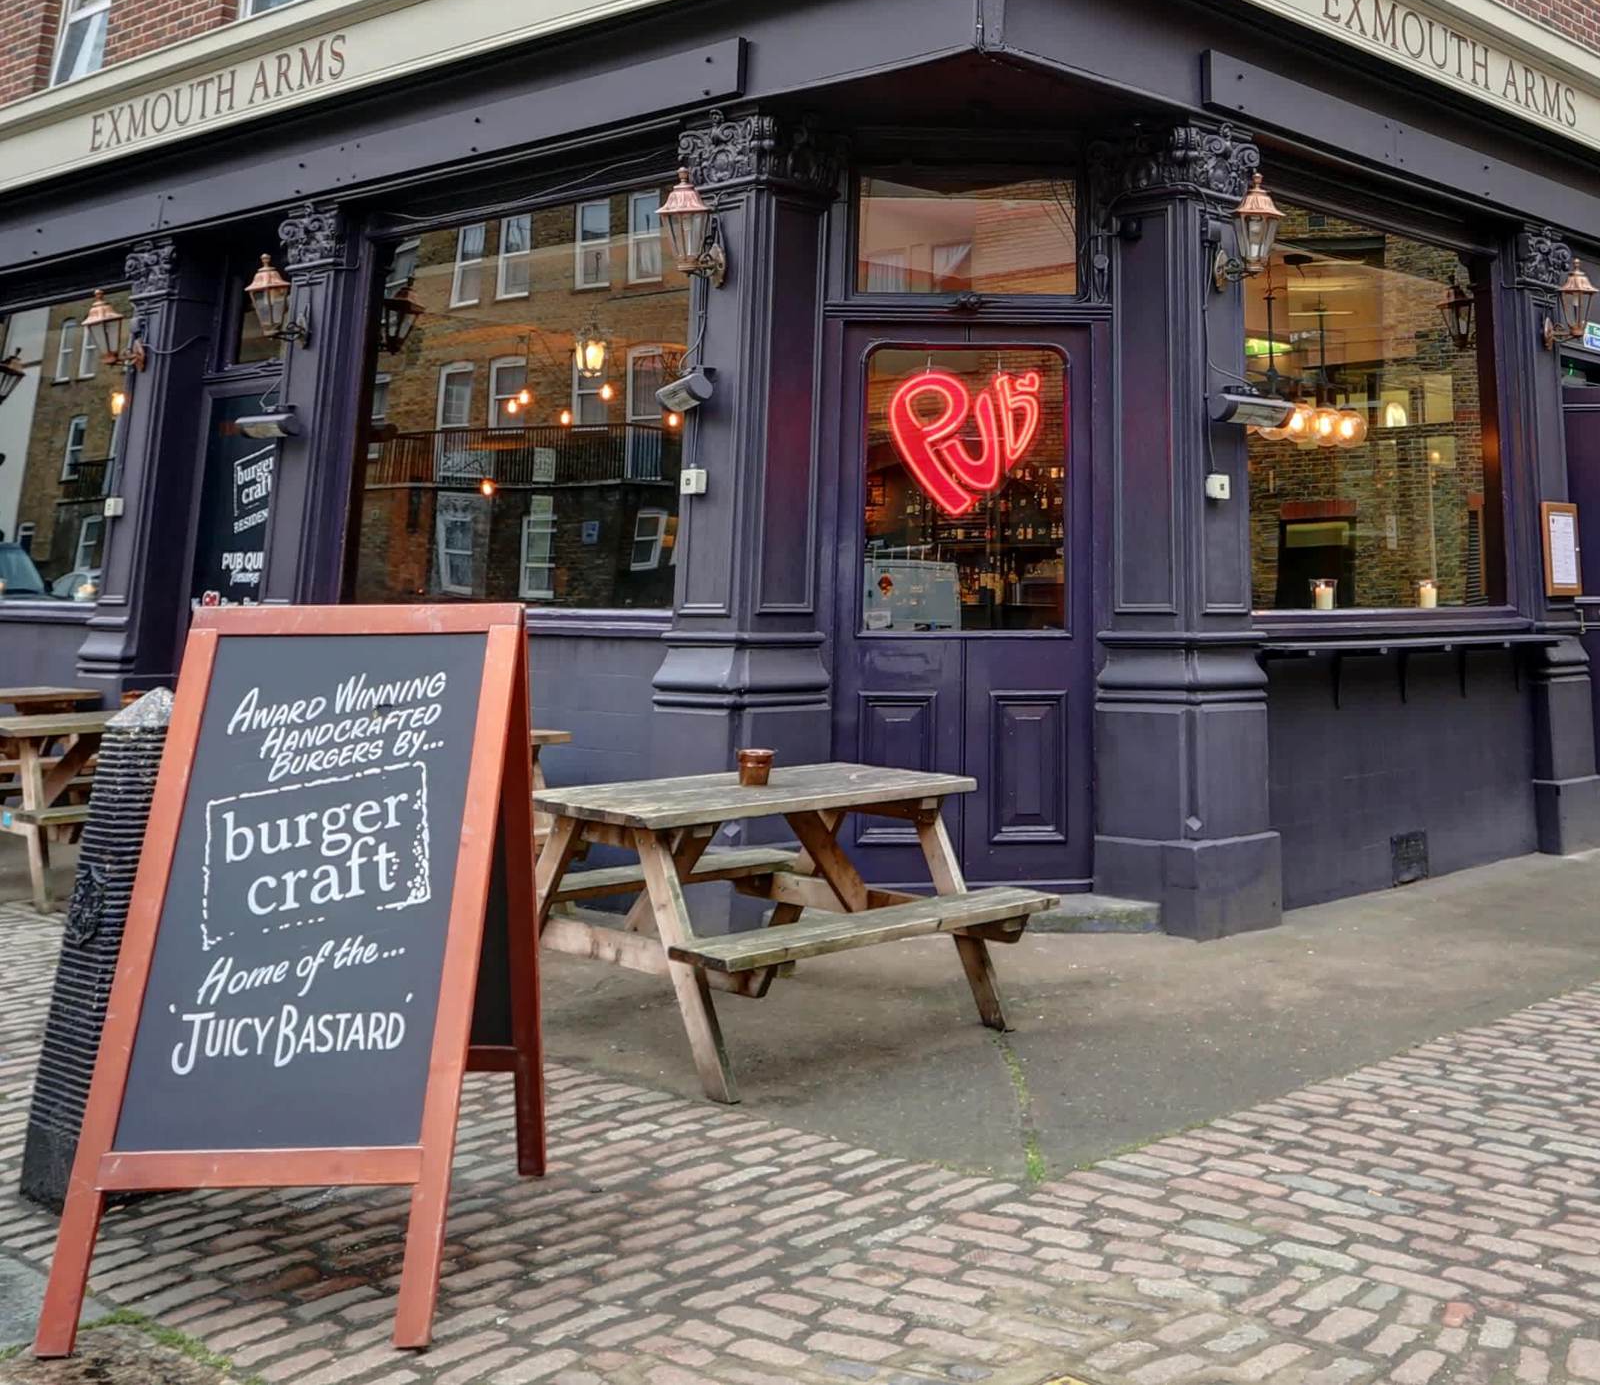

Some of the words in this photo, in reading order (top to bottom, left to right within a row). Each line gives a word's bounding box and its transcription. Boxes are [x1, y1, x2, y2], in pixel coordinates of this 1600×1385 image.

[89, 69, 239, 153] EXMOUTH
[248, 34, 346, 105] ARMS
[1502, 59, 1577, 127] ARMS
[237, 456, 274, 485] burger
[242, 472, 272, 504] craft
[233, 508, 269, 534] RESIDEN
[221, 551, 244, 570] PUB
[244, 551, 264, 571] QUI
[227, 687, 327, 735] AWARD
[335, 671, 447, 715] WINNING
[259, 703, 442, 759] HANDCRAFTED
[267, 739, 384, 783] BURGERS
[222, 791, 409, 864] burger
[246, 837, 397, 916] craft
[197, 957, 287, 1006] Home
[296, 940, 335, 997] of
